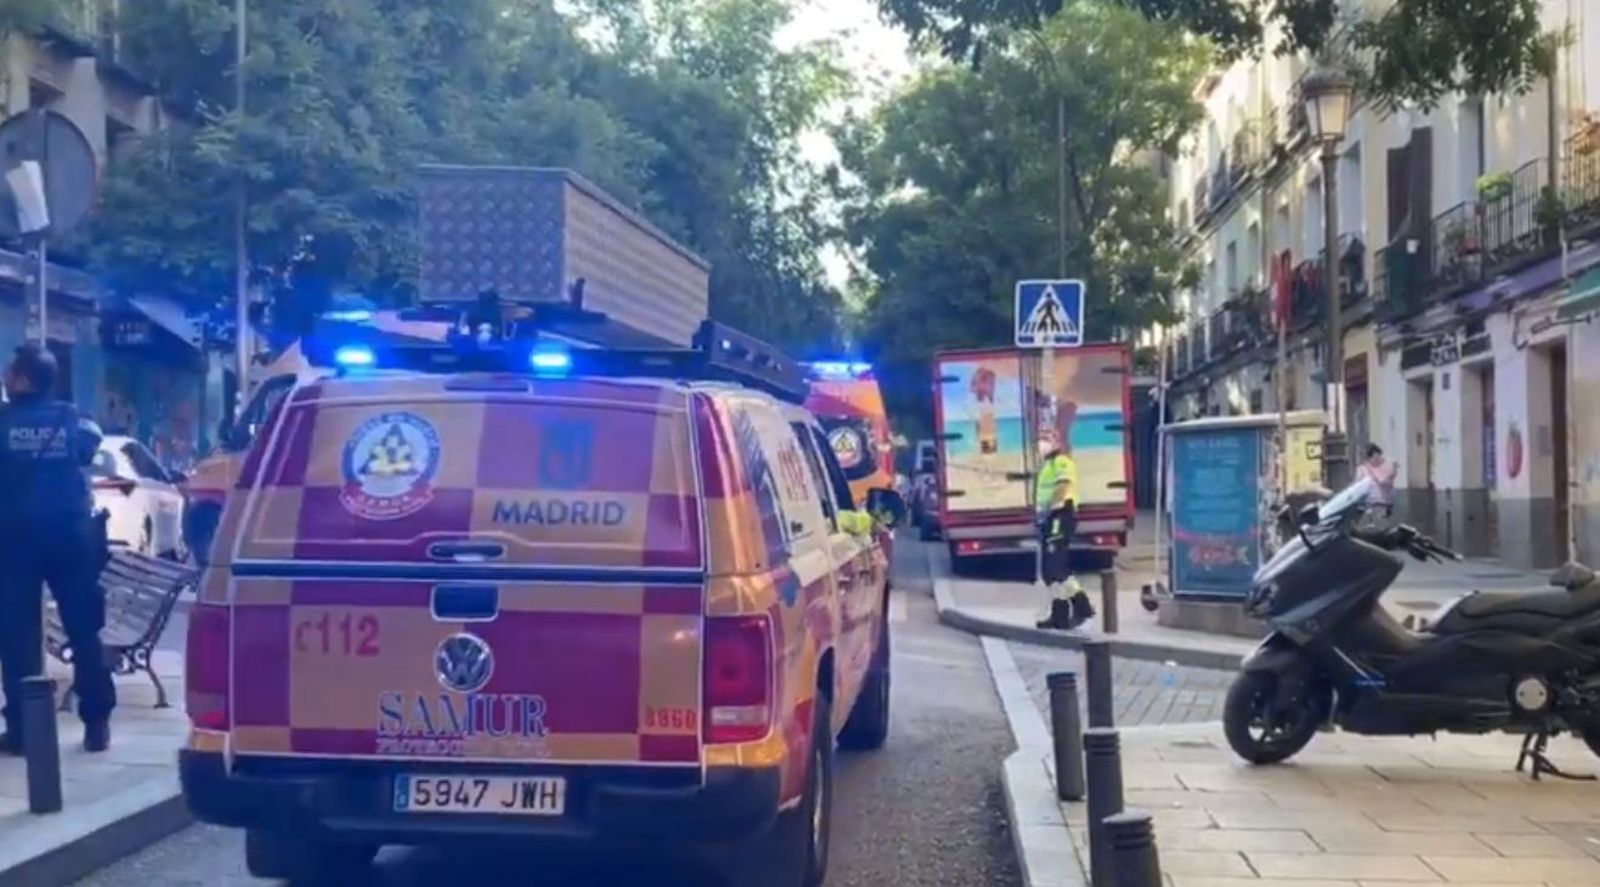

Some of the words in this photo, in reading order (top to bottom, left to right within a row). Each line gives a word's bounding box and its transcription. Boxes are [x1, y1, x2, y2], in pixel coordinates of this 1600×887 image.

[9, 427, 67, 441] POLICA
[491, 499, 625, 525] MADRID
[377, 690, 550, 738] SAMUR
[414, 778, 488, 807] 5947
[501, 781, 557, 809] JWH
